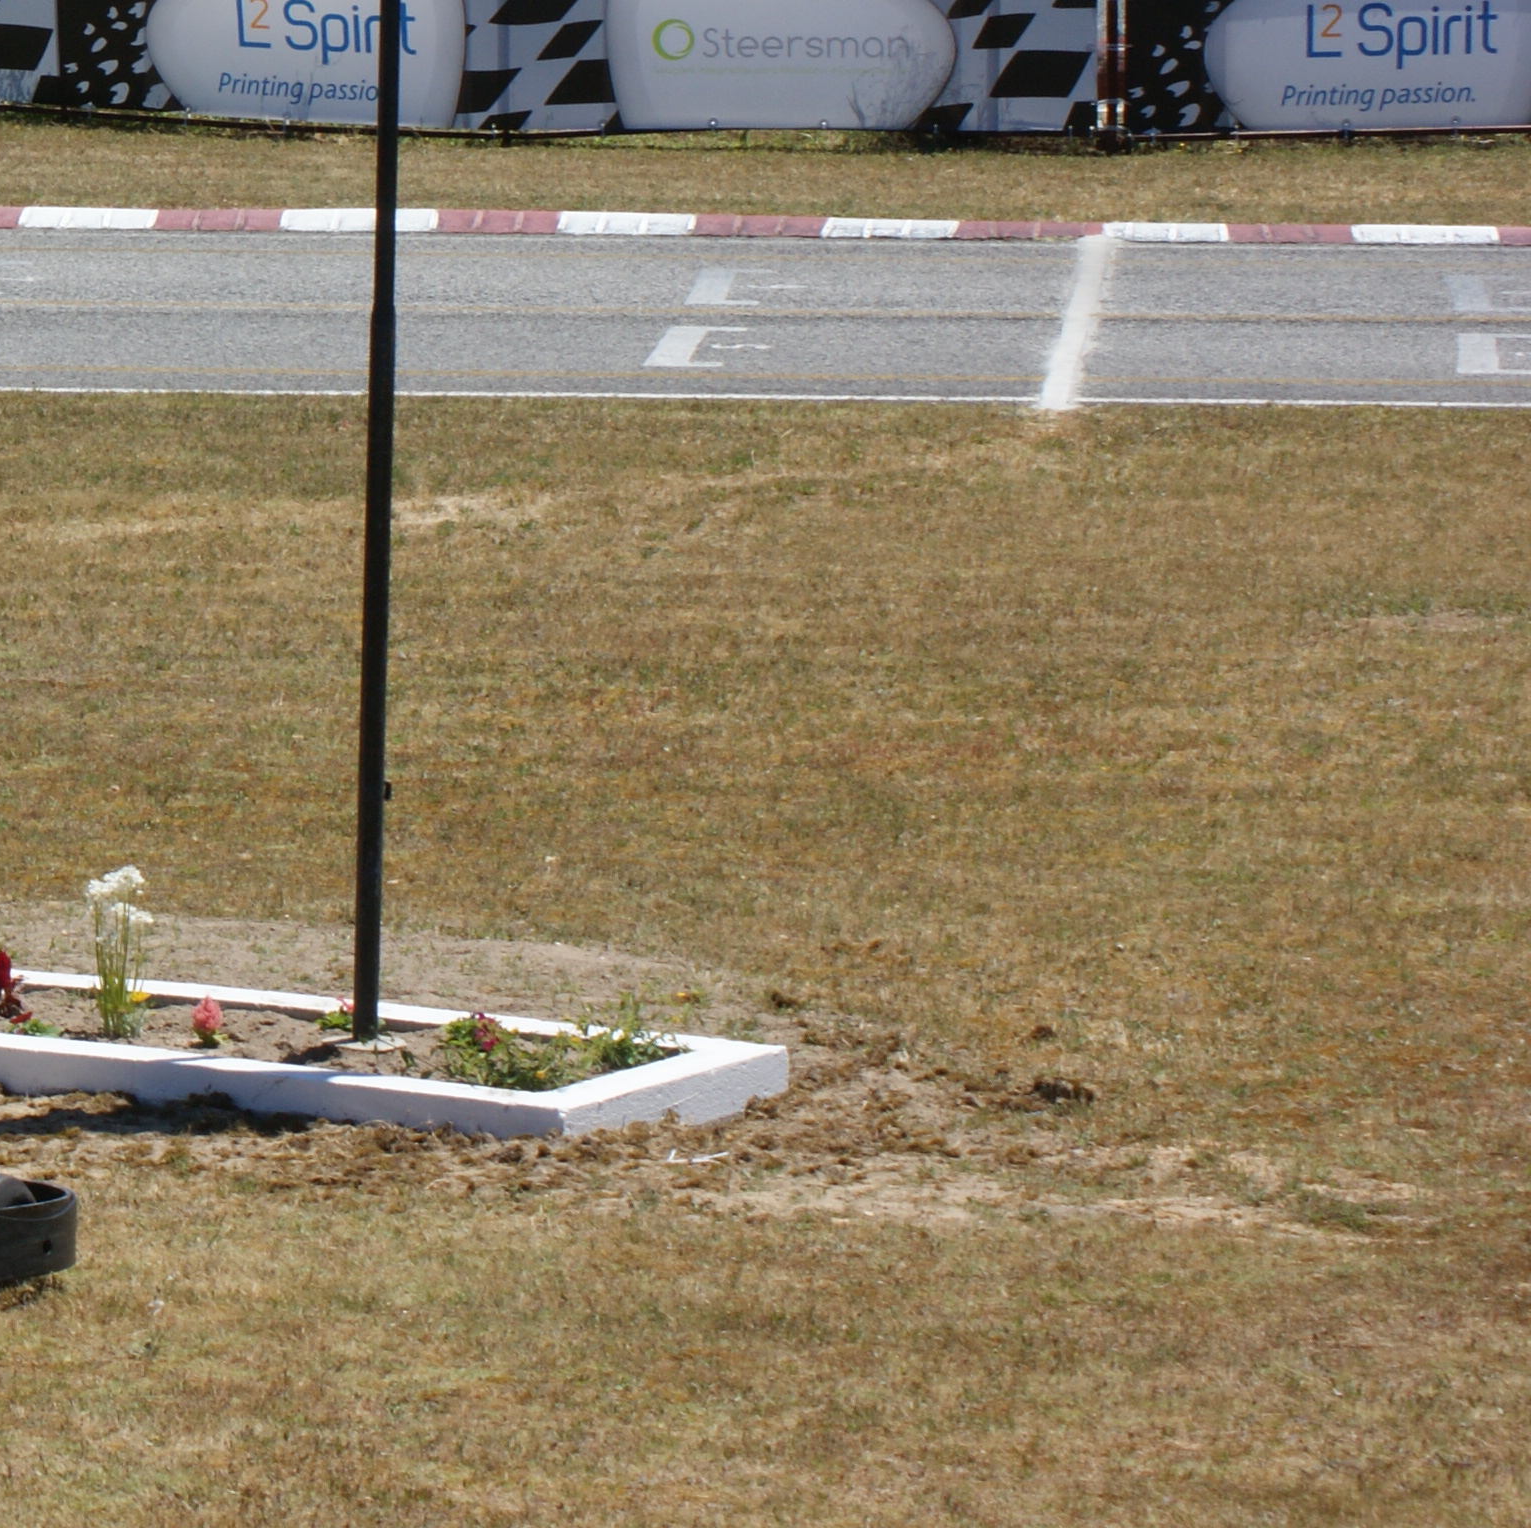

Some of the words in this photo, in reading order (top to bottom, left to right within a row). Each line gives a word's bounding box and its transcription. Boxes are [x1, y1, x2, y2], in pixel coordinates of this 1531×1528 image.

[702, 27, 912, 59] Steersman
[1356, 0, 1499, 70] Spirit
[217, 72, 305, 106] Printing
[1279, 84, 1376, 112] Printing
[1378, 81, 1477, 112] passion.
